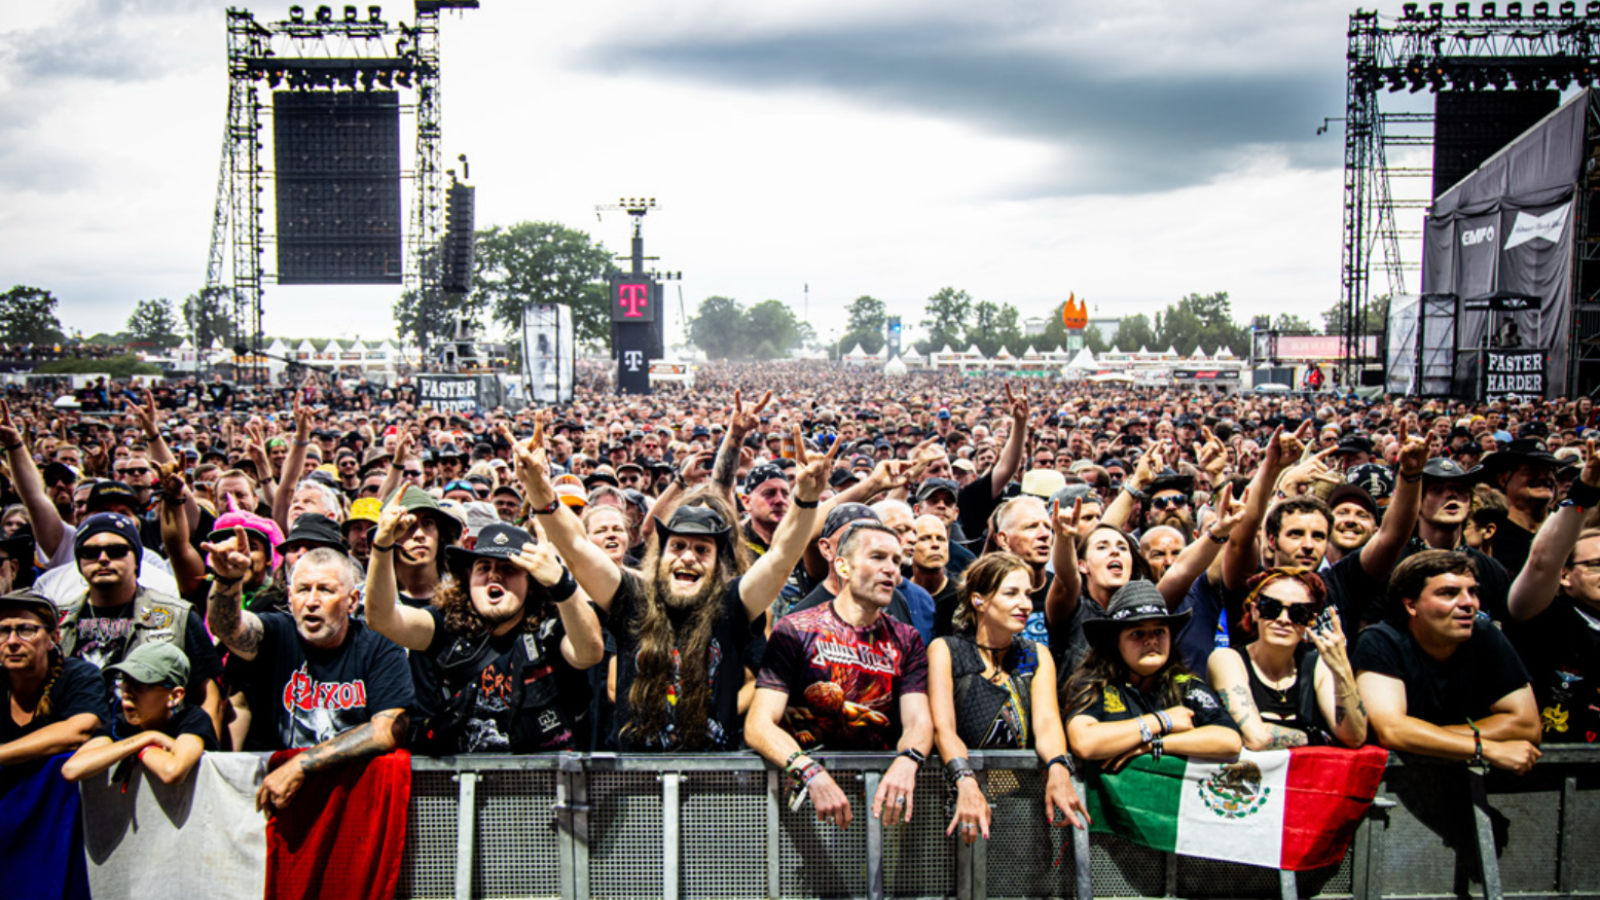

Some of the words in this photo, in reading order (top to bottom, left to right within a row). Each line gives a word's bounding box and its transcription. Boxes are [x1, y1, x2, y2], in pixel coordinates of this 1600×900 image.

[619, 283, 648, 318] T
[624, 350, 643, 372] T
[1487, 352, 1543, 372] FASTER
[420, 379, 477, 398] FASTER
[1486, 373, 1543, 392] HARDER
